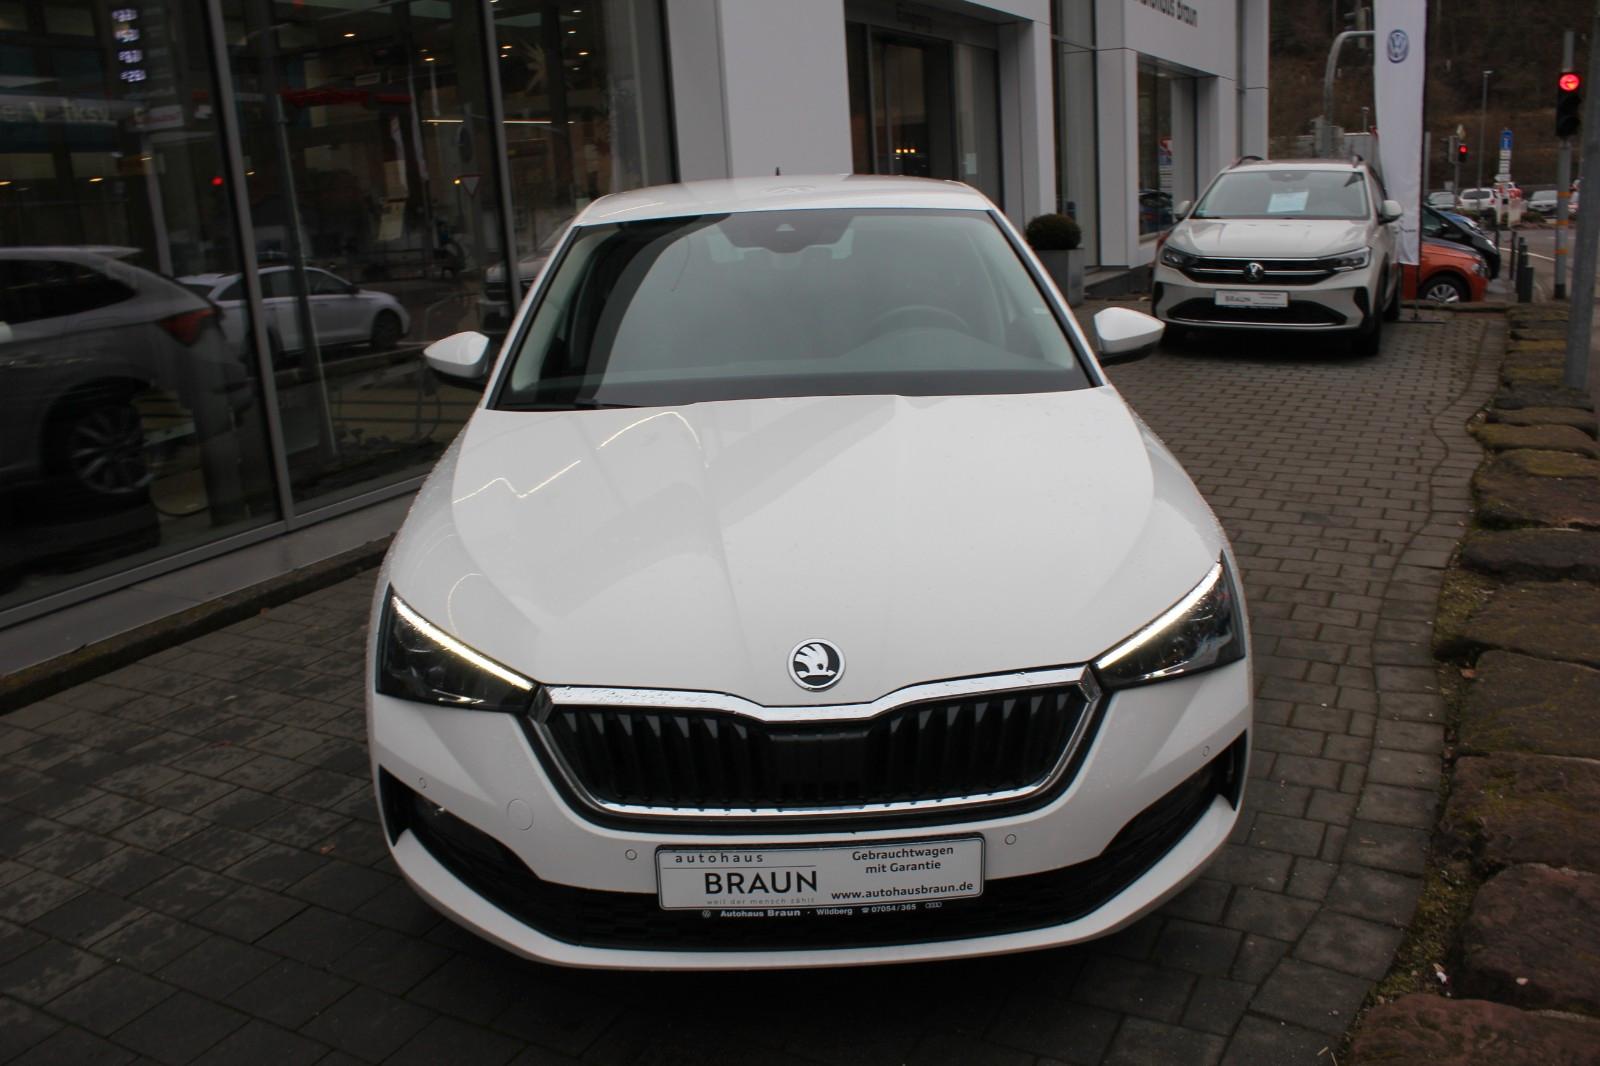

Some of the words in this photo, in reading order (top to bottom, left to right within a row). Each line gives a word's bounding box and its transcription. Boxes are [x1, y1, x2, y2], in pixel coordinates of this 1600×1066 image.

[675, 851, 764, 863] autohaus
[851, 845, 954, 862] Gebrauchtwagen
[864, 863, 887, 874] mit
[889, 859, 941, 873] Garantie
[704, 870, 817, 894] BRAUN
[830, 881, 973, 899] www.autohausbraun.de
[719, 909, 765, 918] Autohaus
[767, 909, 801, 917] Braun
[816, 907, 853, 917] Wildberg
[871, 904, 917, 914] 07054/365
